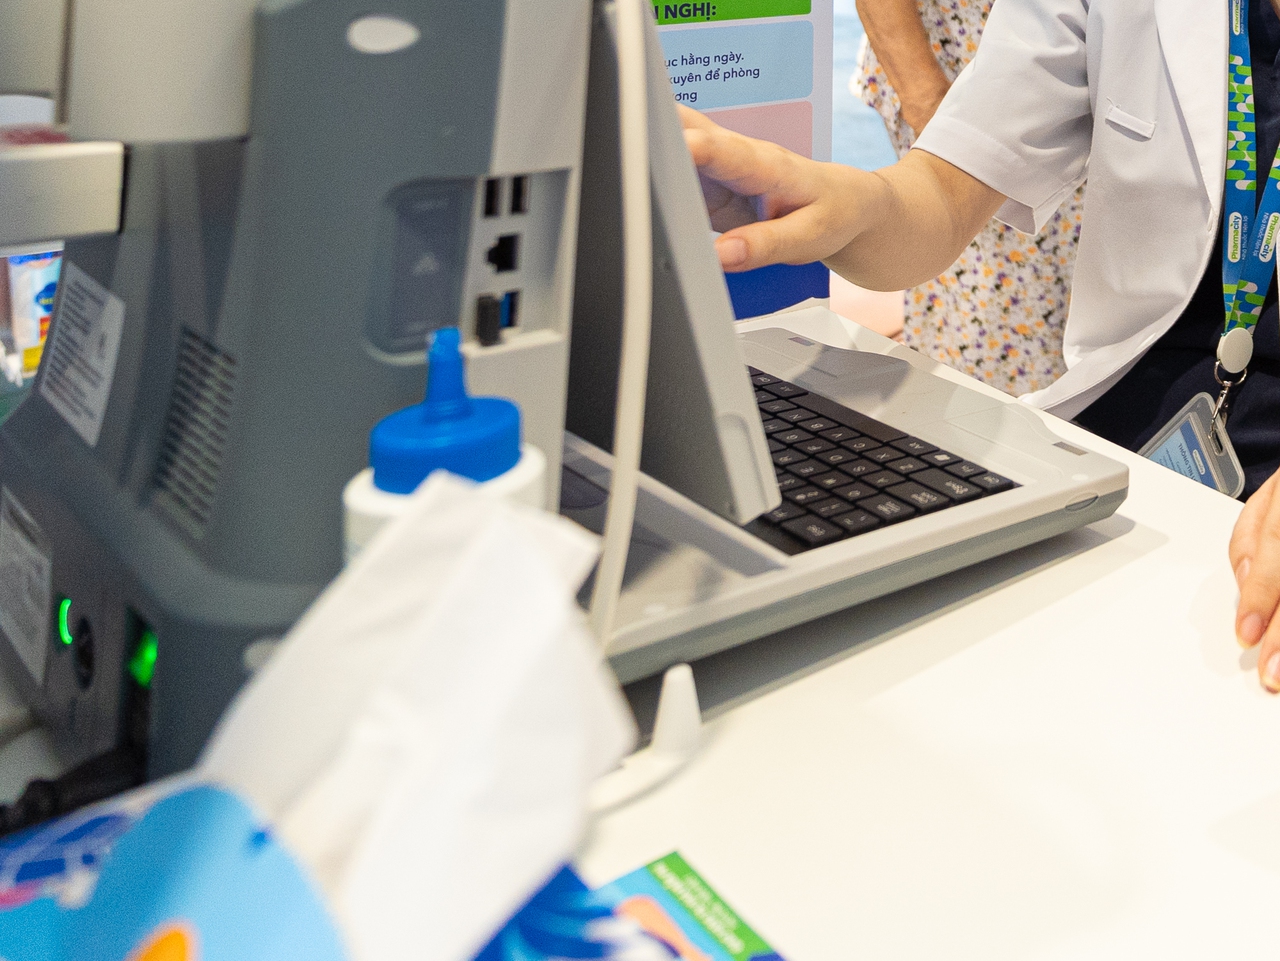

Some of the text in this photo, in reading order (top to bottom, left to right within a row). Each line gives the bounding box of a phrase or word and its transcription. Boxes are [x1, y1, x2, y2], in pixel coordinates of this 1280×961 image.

[664, 1, 718, 21] NGHỊ:
[664, 51, 744, 72] ục hằng ngày.
[705, 66, 760, 83] để phòng
[674, 89, 698, 105] ơng
[1230, 215, 1241, 259] Pharmacity
[1260, 214, 1279, 259] Pharmacity
